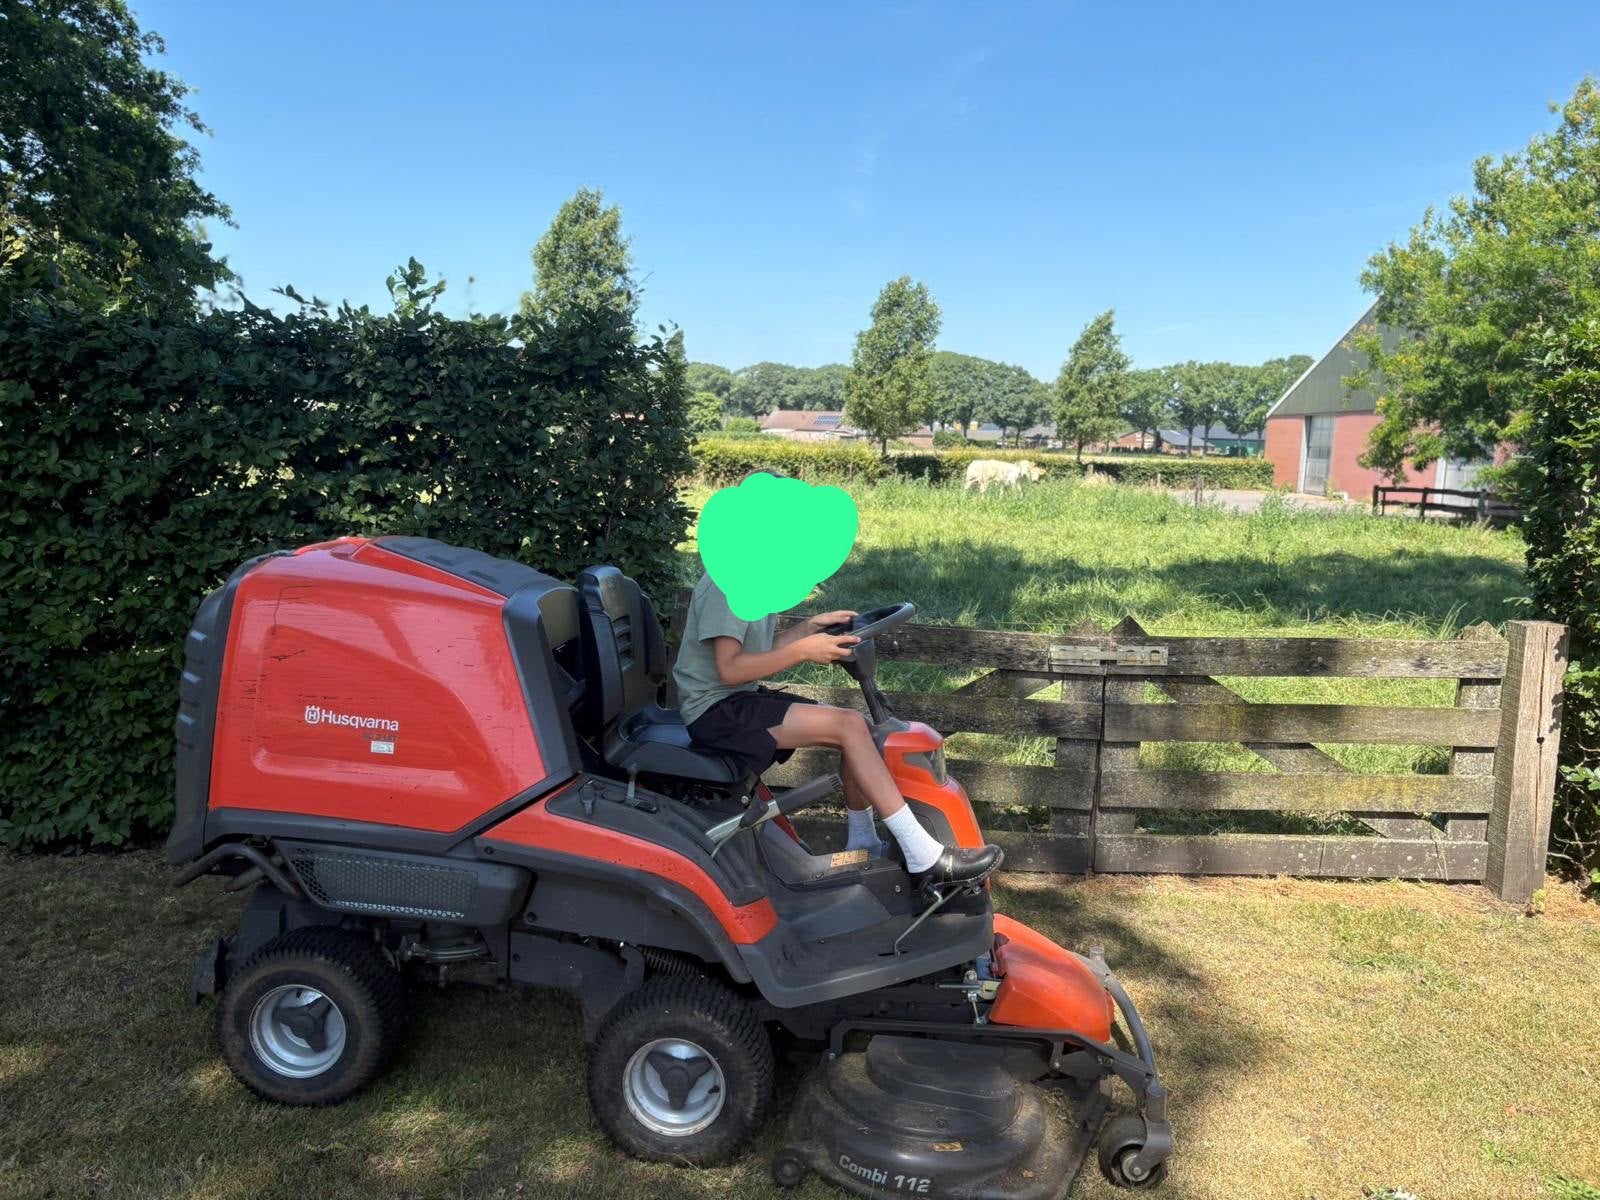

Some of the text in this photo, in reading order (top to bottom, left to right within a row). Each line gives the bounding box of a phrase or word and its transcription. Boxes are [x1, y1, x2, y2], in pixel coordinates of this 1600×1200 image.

[321, 709, 399, 731] Husqvarna
[839, 1155, 931, 1193] Combi 112
